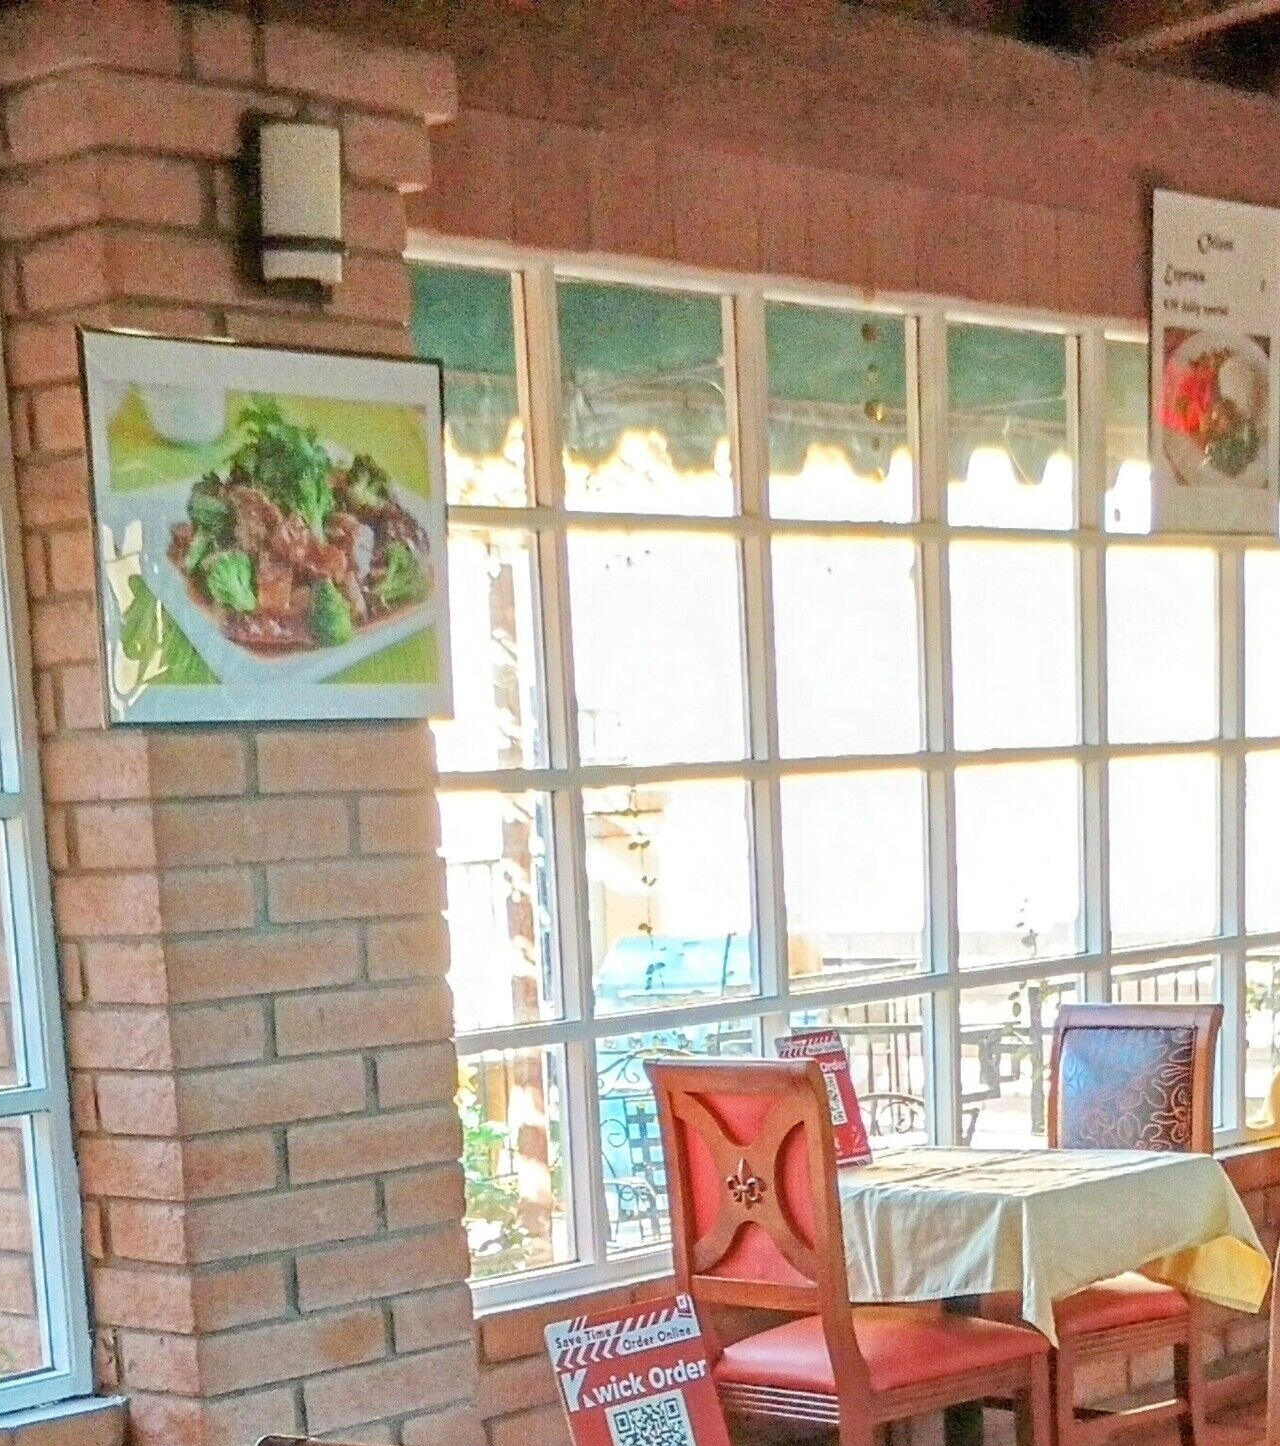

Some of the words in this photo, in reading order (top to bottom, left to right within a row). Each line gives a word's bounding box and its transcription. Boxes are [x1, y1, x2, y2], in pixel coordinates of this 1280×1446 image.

[554, 1335, 582, 1350] Save
[584, 1327, 612, 1341] Time
[622, 1335, 654, 1351] Order
[656, 1326, 692, 1342] Online
[648, 1358, 708, 1390] Order
